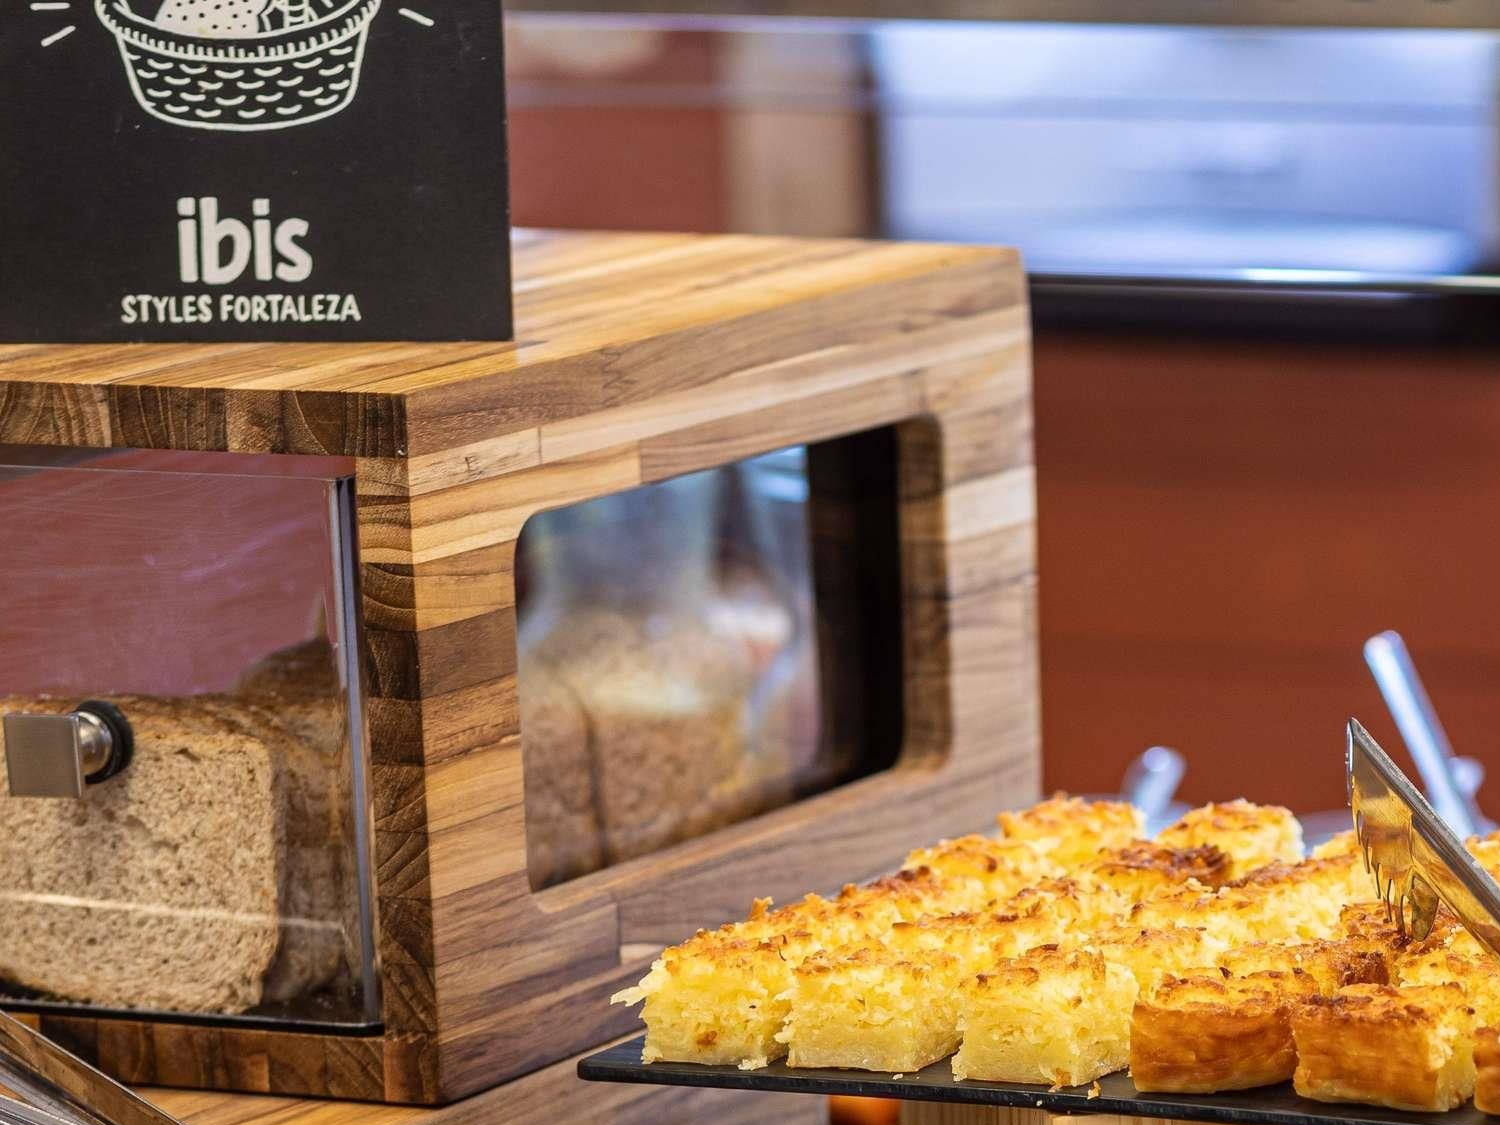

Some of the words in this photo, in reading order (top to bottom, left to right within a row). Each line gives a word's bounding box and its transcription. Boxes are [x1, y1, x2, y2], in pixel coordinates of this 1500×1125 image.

[176, 196, 313, 285] ibis
[120, 293, 213, 324] STYLES
[219, 293, 362, 323] FORTALEZA
